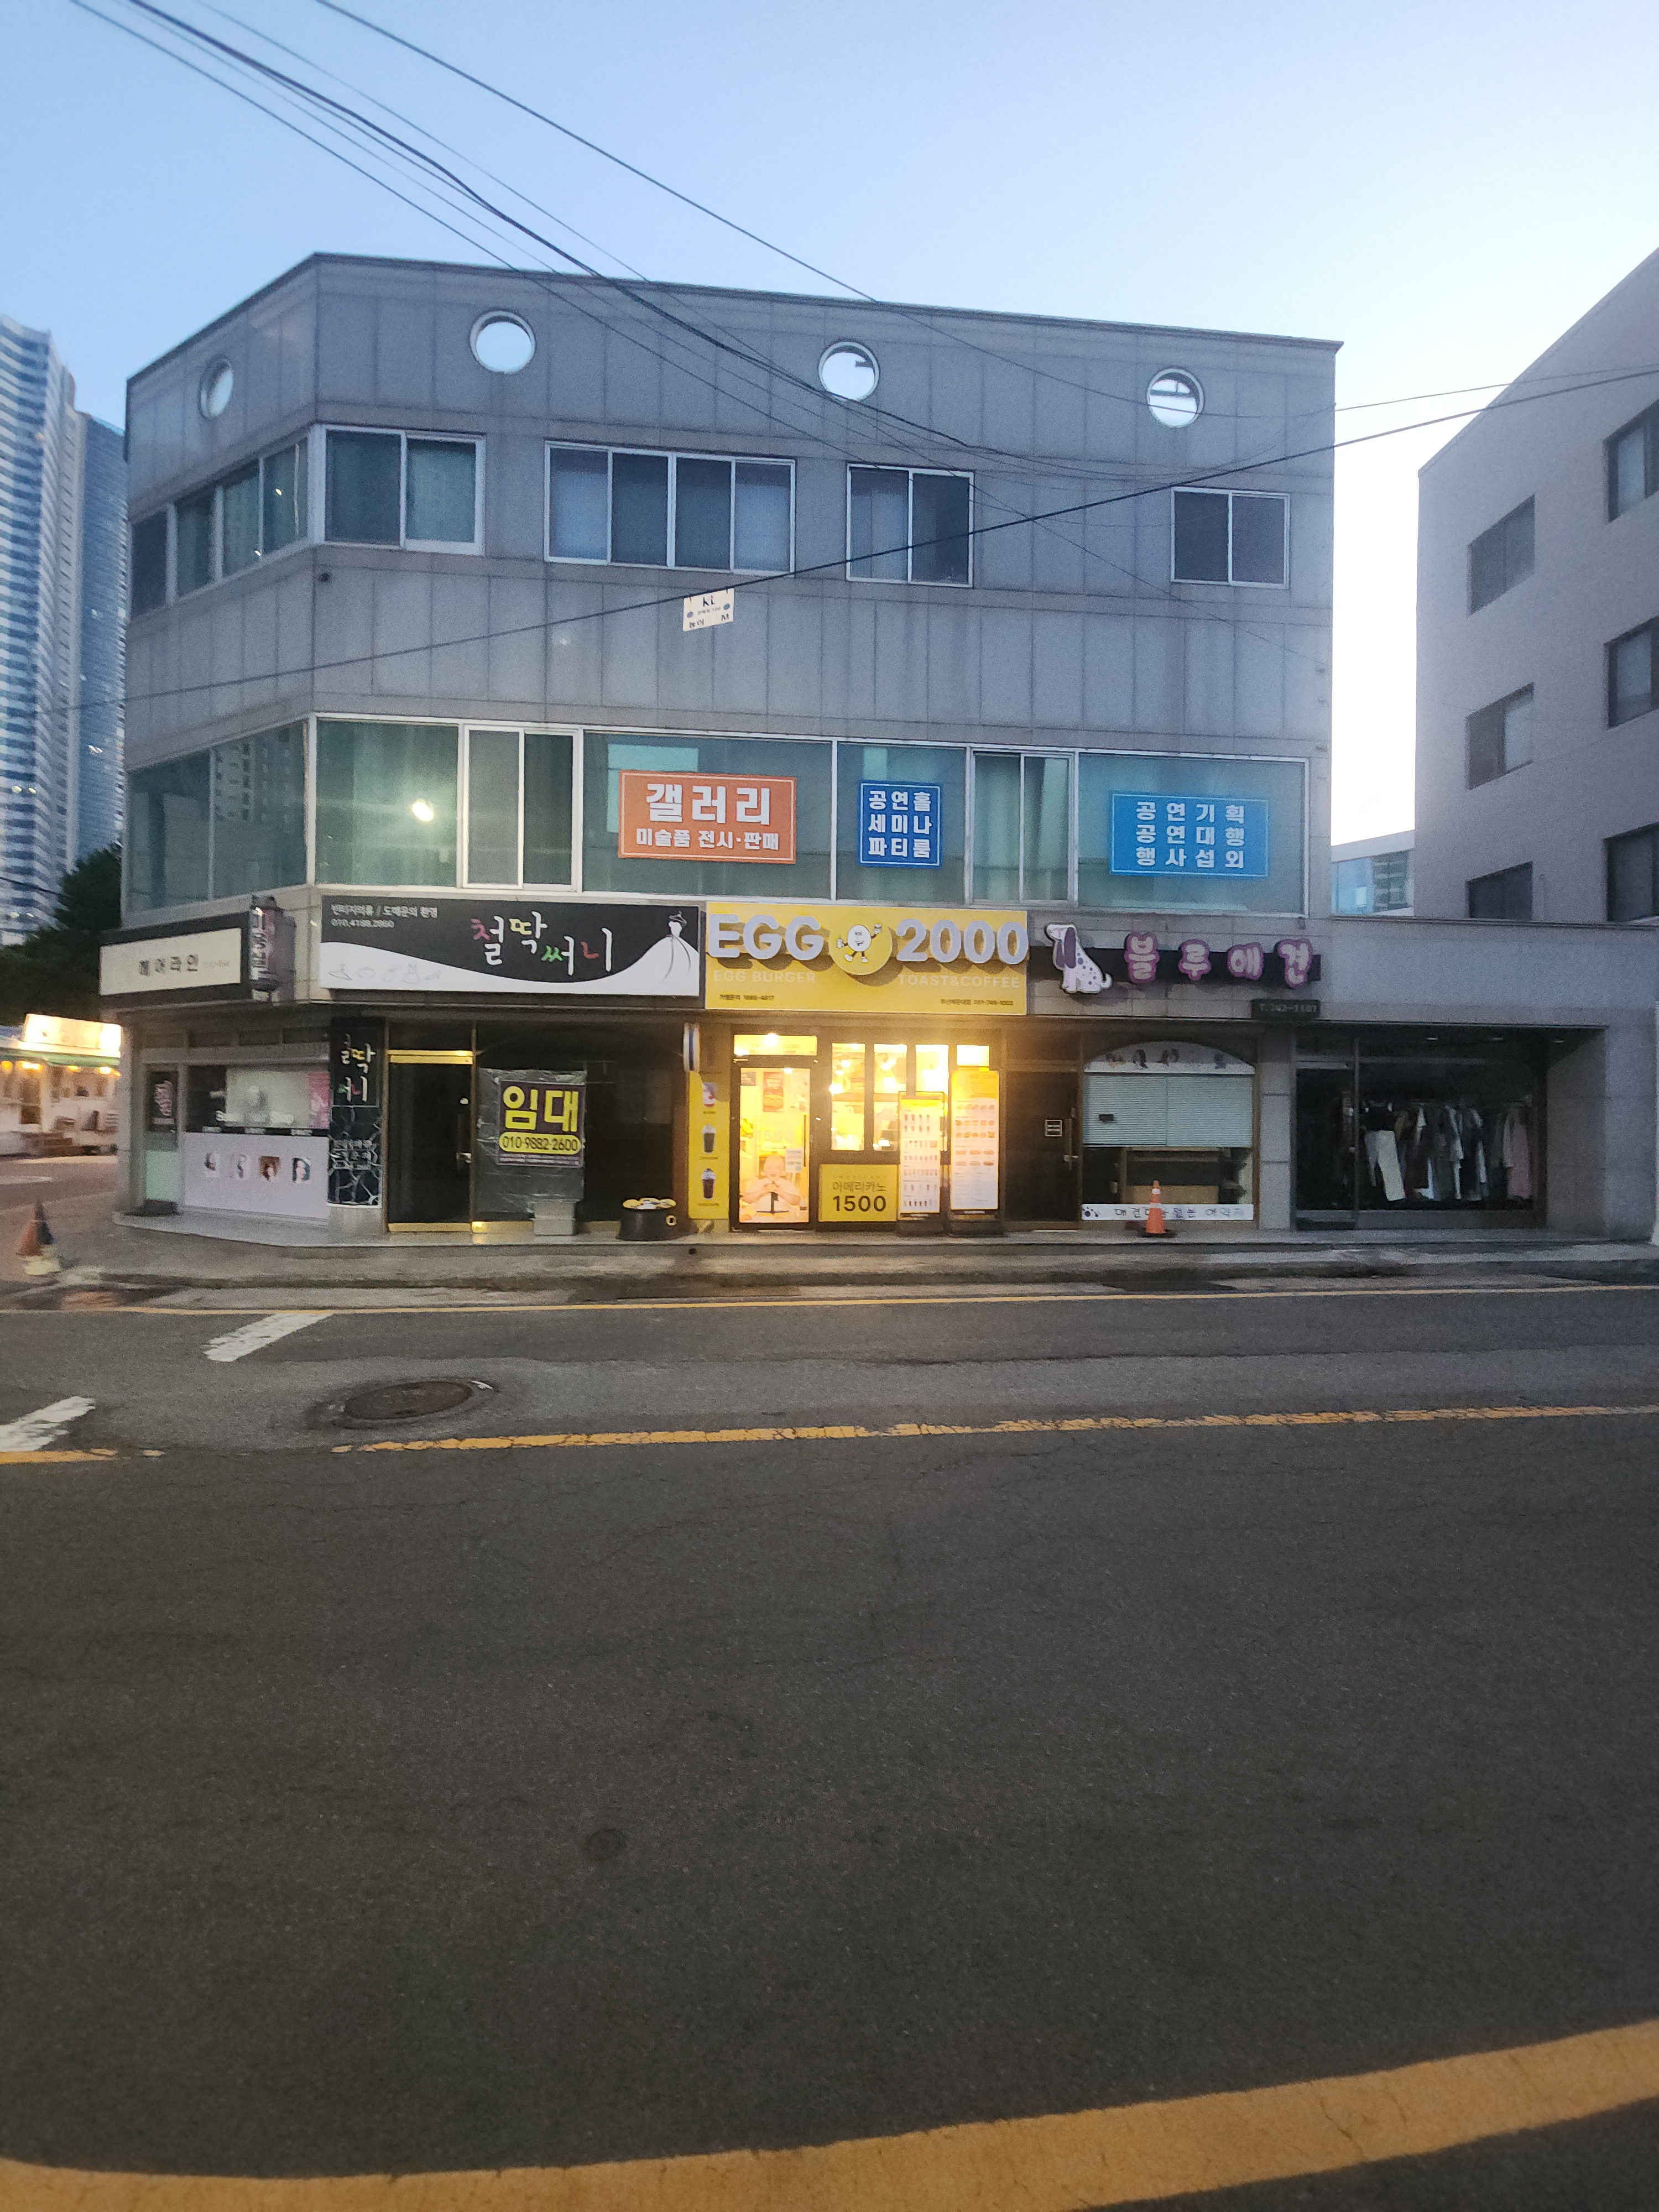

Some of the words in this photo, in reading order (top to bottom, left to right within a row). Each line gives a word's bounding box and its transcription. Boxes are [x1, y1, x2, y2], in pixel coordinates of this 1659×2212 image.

[646, 784, 770, 825] 갤러리
[869, 790, 931, 812] 공연홀
[1136, 801, 1244, 824] 공연기획
[868, 813, 932, 836] 세미나
[1136, 824, 1244, 847] 공연대행
[636, 828, 691, 848] 미술품
[698, 831, 779, 850] 전시·판매
[868, 838, 931, 859] 파티룸
[1136, 847, 1244, 869] 행사섭외
[470, 911, 612, 975] 철딱써니
[708, 914, 824, 961] EGG
[896, 919, 1028, 964] 2000
[713, 970, 747, 982] EGG
[752, 971, 816, 983] BURGER
[898, 974, 1020, 989] TOAST&COFFEE
[503, 1086, 579, 1133] 임대
[832, 1181, 887, 1193] 아메리카노
[833, 1195, 886, 1212] 1500
